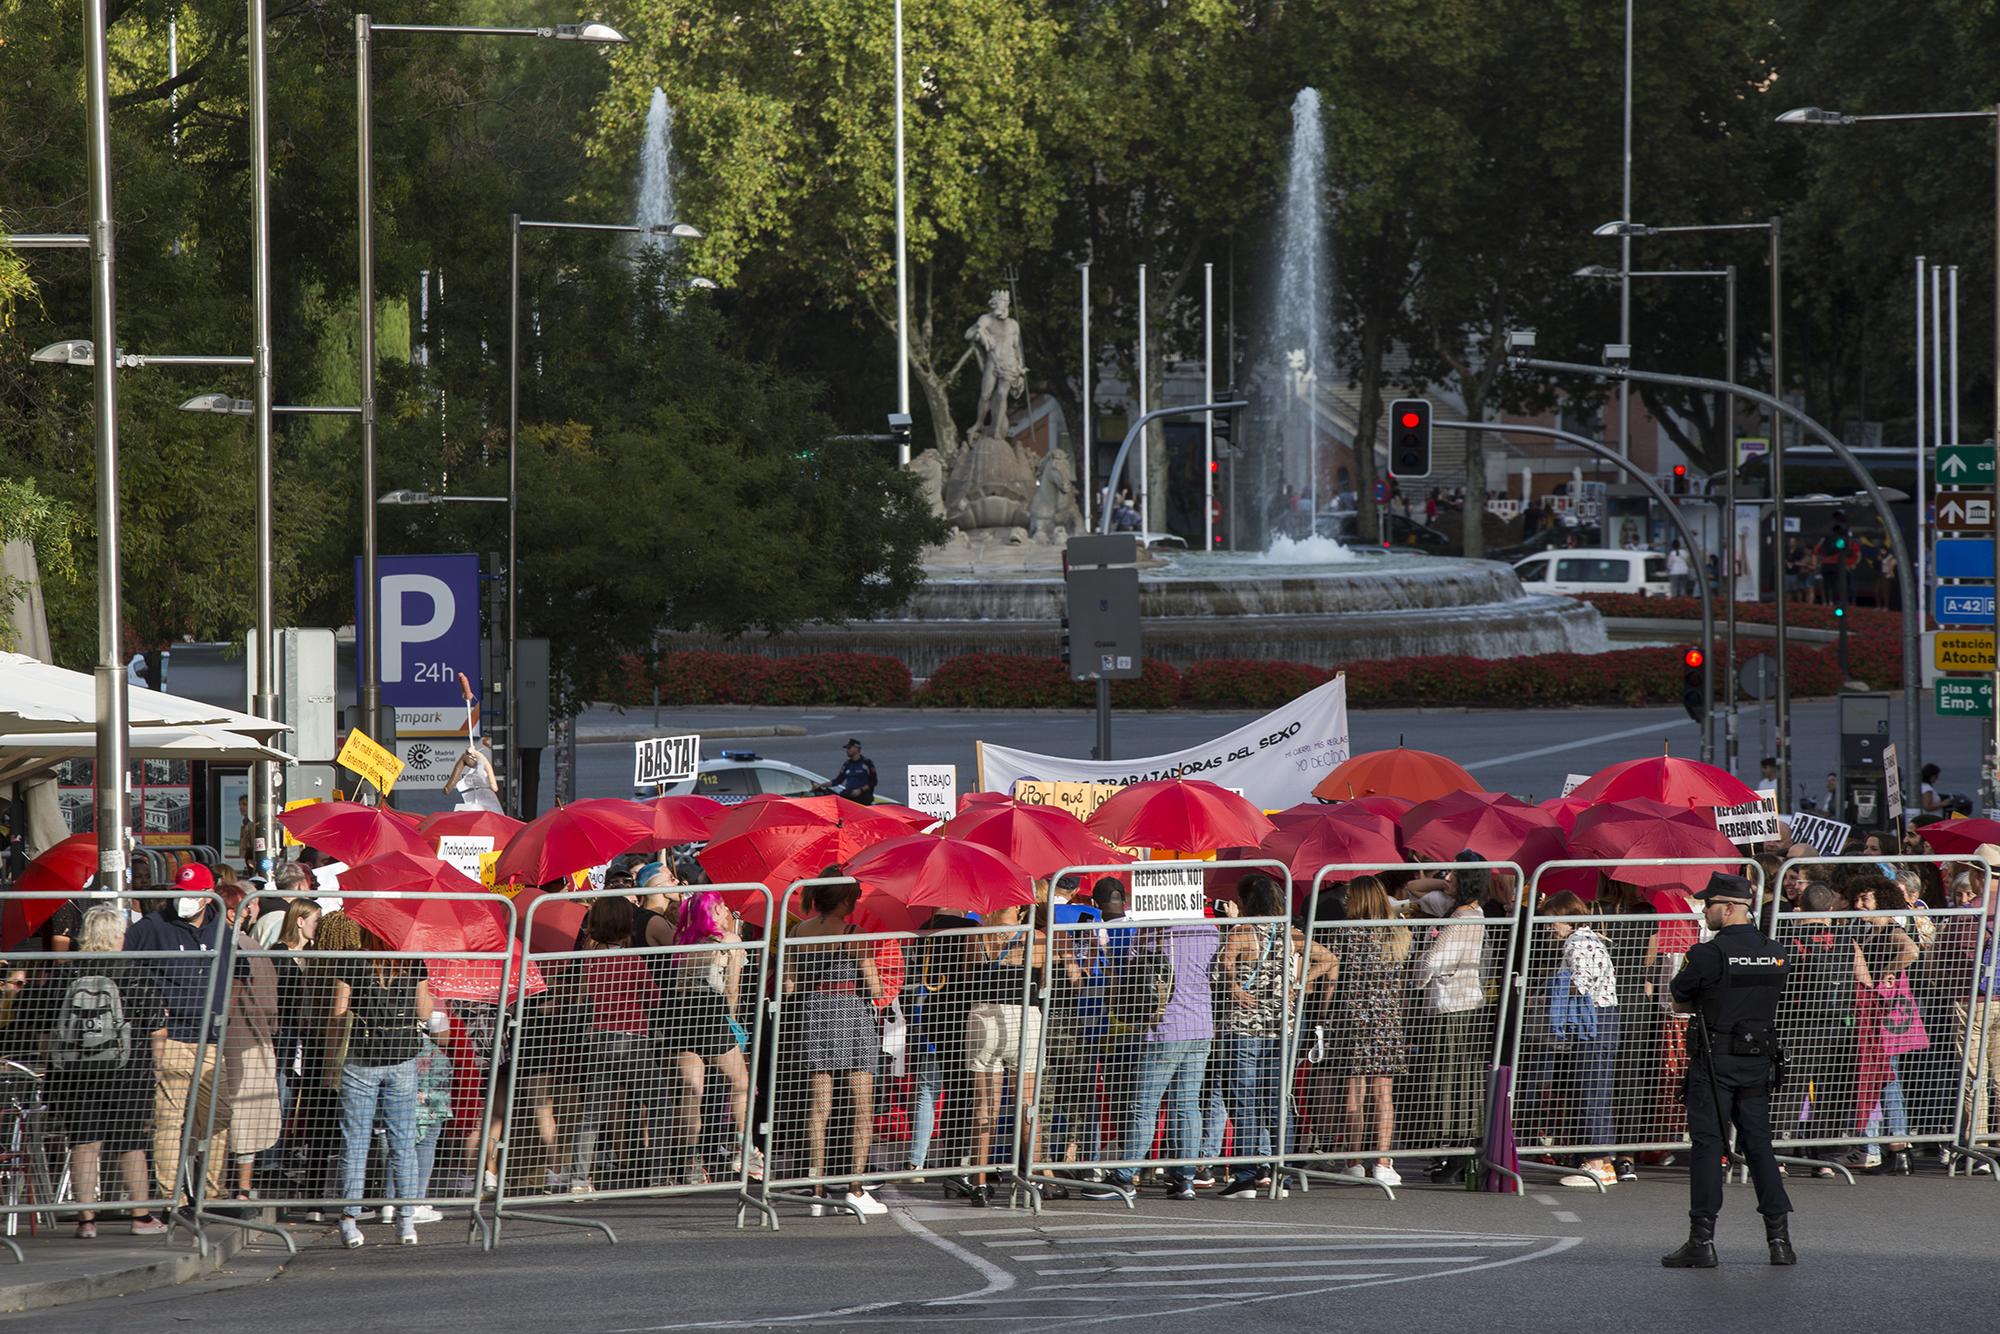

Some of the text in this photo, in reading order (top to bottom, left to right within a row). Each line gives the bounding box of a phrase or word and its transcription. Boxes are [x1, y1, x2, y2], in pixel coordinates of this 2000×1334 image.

[1947, 600, 1981, 612] A-42
[381, 574, 455, 683] P
[1942, 639, 1992, 649] estación
[414, 662, 454, 682] 24h
[1941, 684, 1972, 697] plaza
[1941, 696, 1979, 711] Emp.
[1227, 746, 1255, 763] DEL
[1259, 721, 1302, 749] SEXO
[637, 737, 696, 783] ¡BASTA!
[703, 775, 718, 785] 112
[911, 774, 951, 789] EL TRABAJO
[917, 792, 945, 805] SEXUAL
[1061, 789, 1084, 806] qué
[1719, 820, 1766, 838] DERECHOS,
[1187, 868, 1202, 886] NO!
[1135, 890, 1203, 912] DERECHOS, SÍ!
